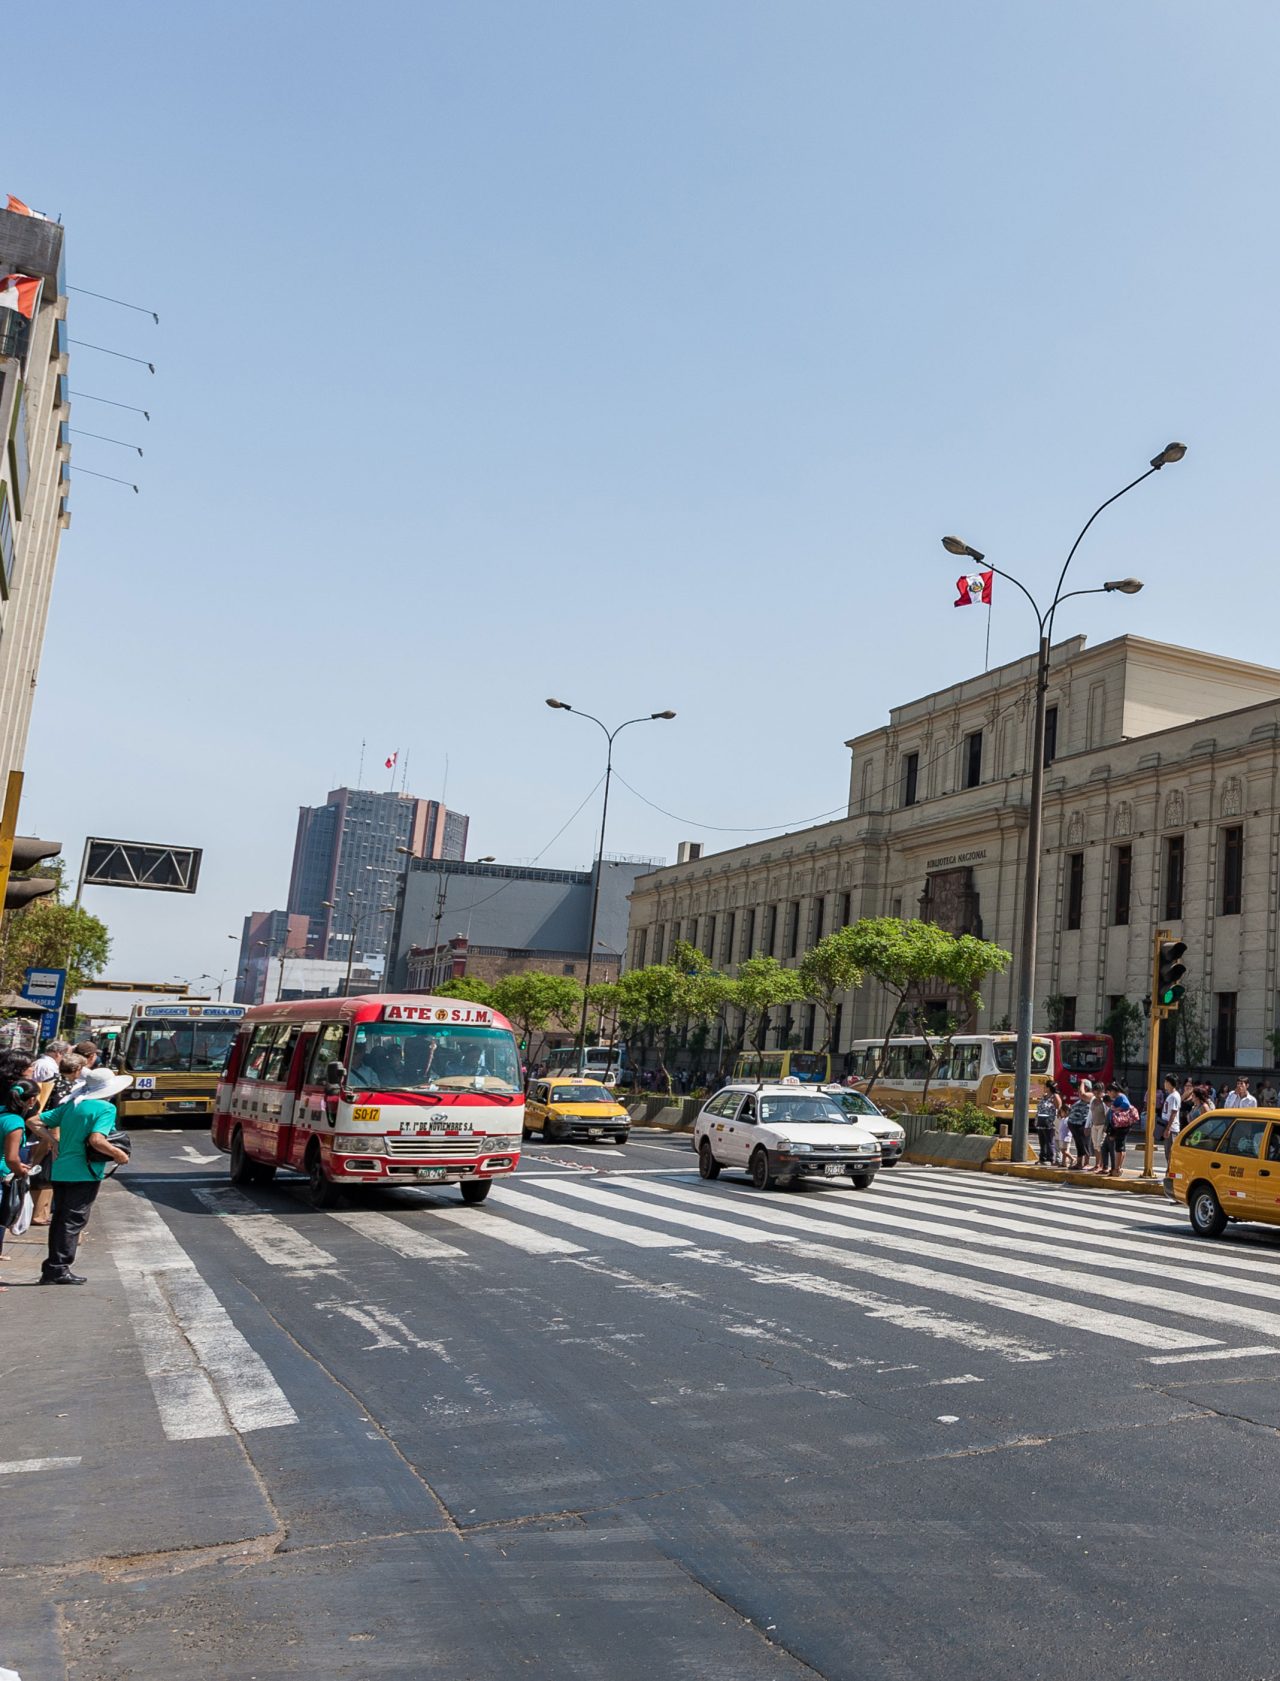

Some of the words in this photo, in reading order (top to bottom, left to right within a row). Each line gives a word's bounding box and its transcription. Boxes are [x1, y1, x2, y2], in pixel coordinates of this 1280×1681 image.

[927, 856, 956, 869] BIBLIOTECA
[958, 849, 987, 863] NACIONAL
[388, 1006, 431, 1020] ATE
[452, 1010, 491, 1023] S.J.M.
[138, 1079, 152, 1088] 48
[420, 1122, 428, 1131] DE
[429, 1122, 463, 1131] NOVIEMBRE
